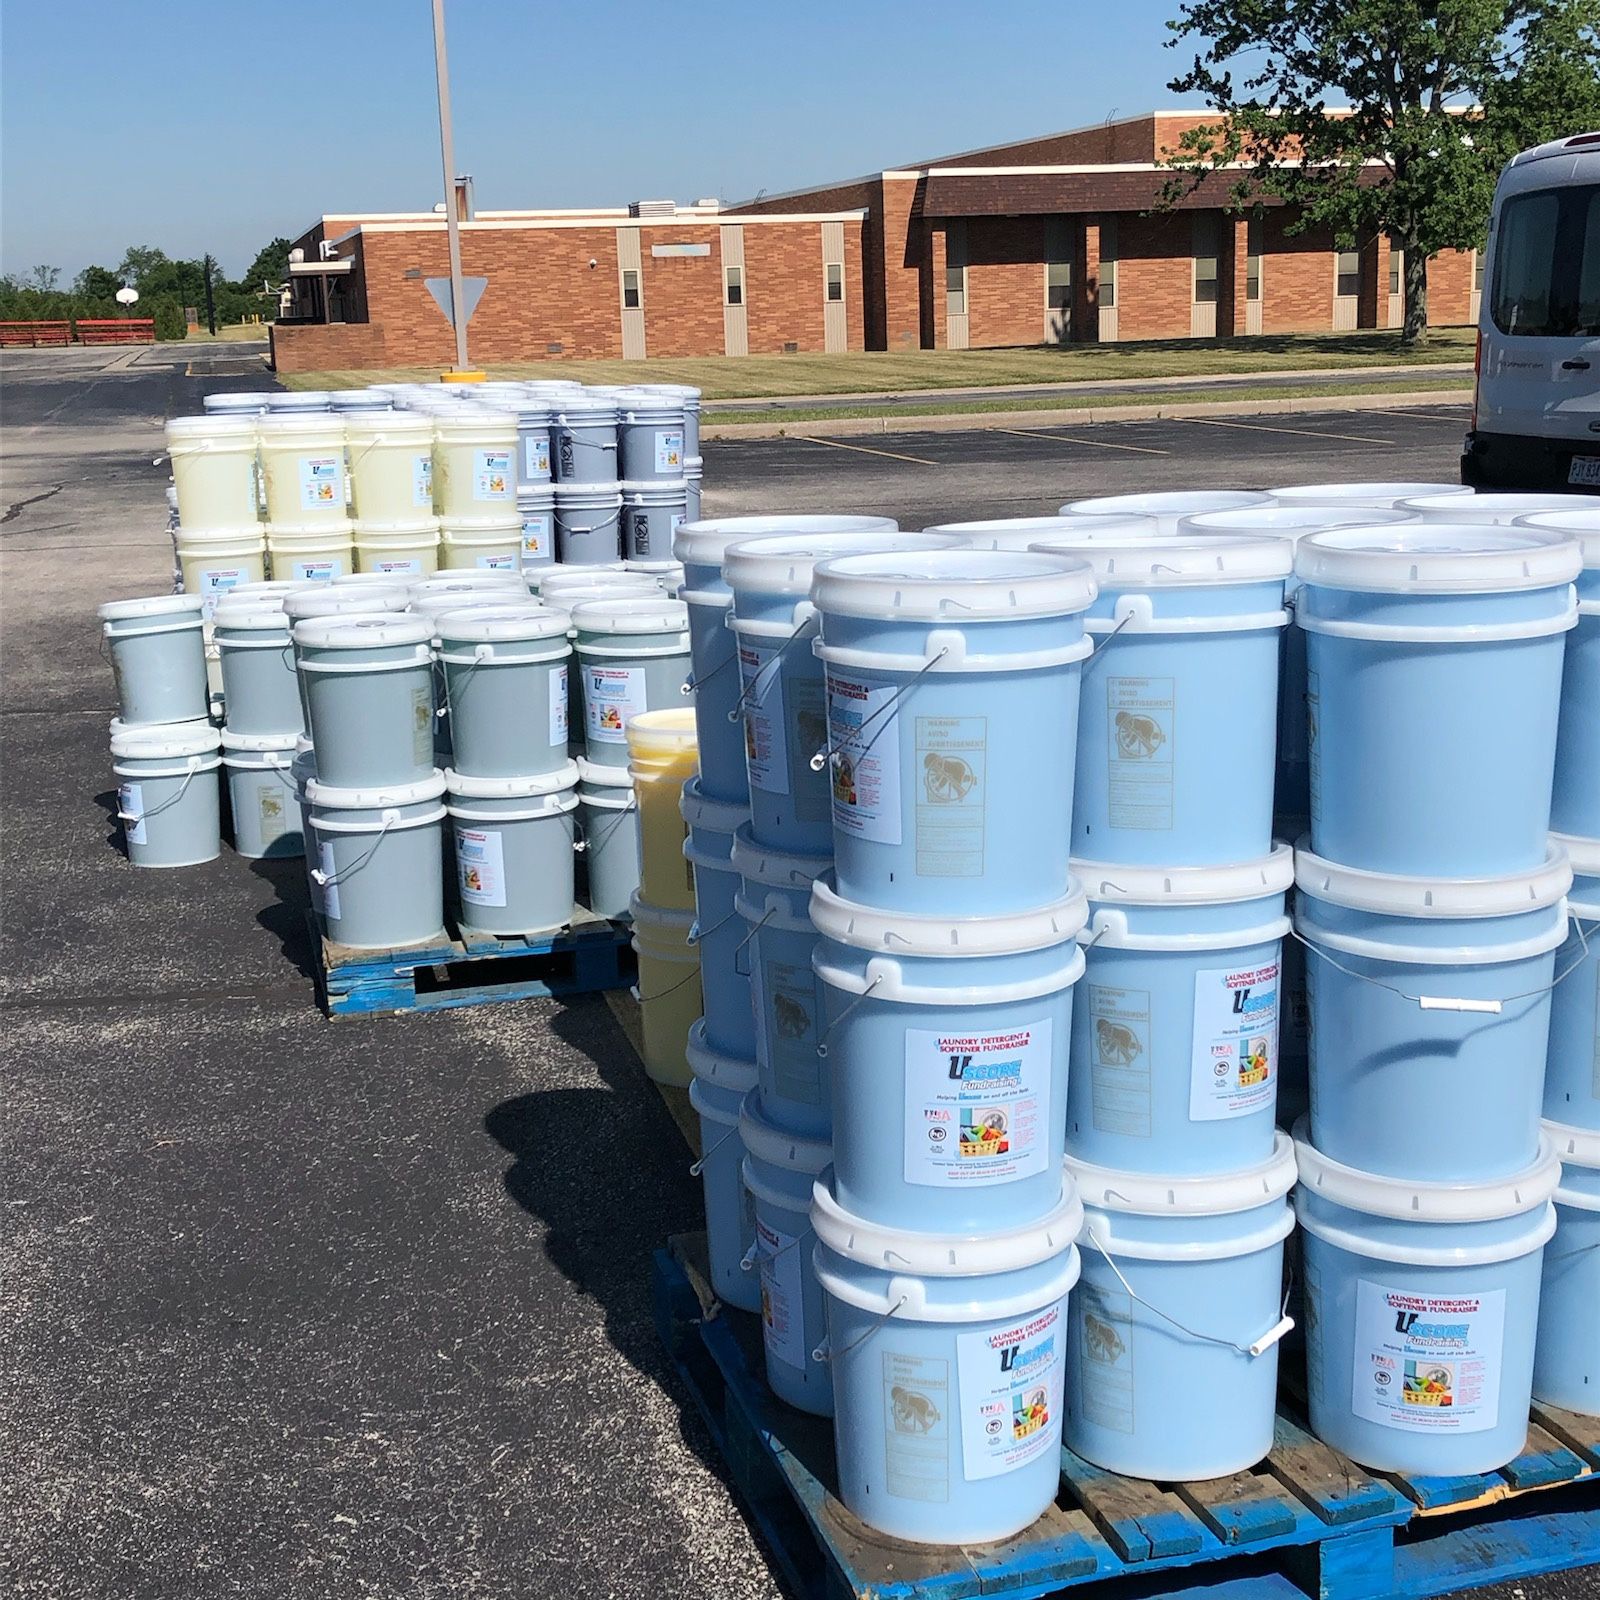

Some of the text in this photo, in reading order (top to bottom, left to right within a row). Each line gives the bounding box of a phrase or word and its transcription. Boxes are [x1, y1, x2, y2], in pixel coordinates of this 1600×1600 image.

[1225, 972, 1254, 982] LAUNDRY
[938, 1038, 978, 1046] LAUNDRY
[981, 1032, 1023, 1045] DETERGENT
[940, 1039, 1029, 1053] SOFTENER FUNDRAISER
[961, 1076, 1019, 1090] Fundraising
[1386, 1293, 1426, 1306] LAUNDRY
[1388, 1301, 1427, 1312] SOFTENER
[988, 1328, 1023, 1343] LAUNDRY
[991, 1334, 1026, 1350] SOFTENER
[1406, 1336, 1465, 1348] Fundraising
